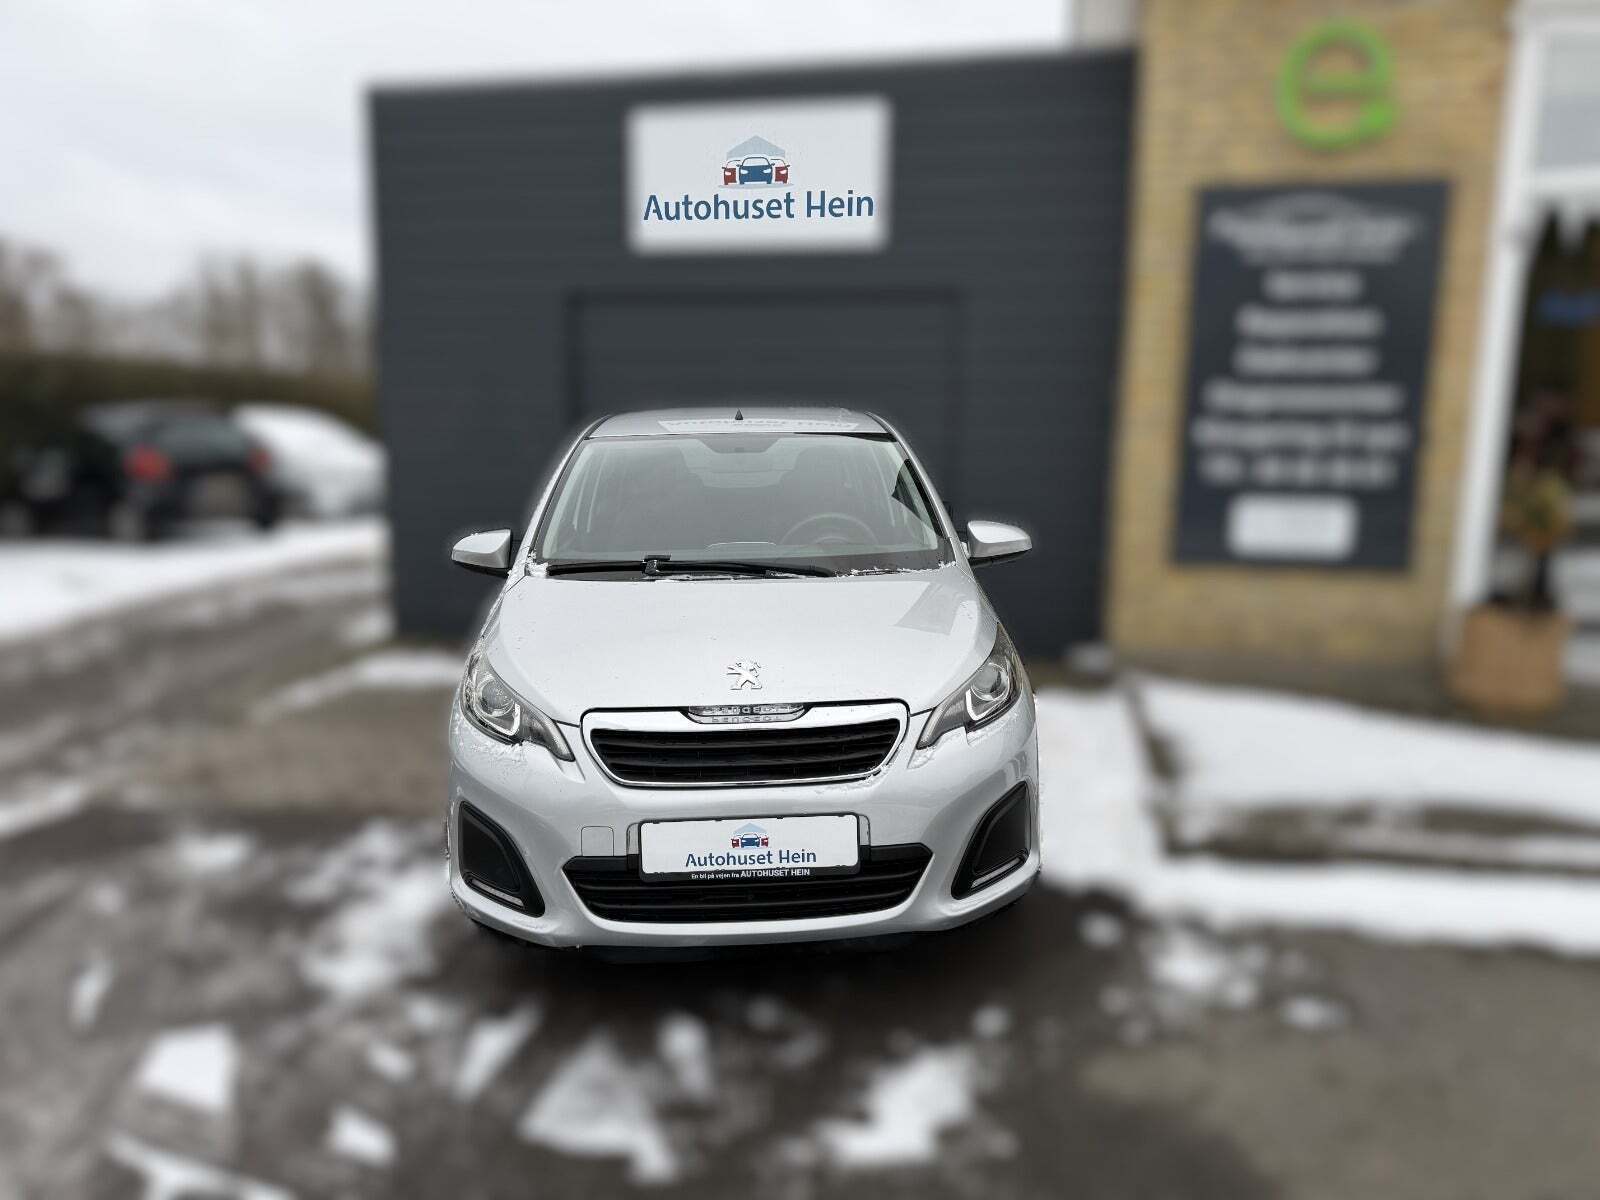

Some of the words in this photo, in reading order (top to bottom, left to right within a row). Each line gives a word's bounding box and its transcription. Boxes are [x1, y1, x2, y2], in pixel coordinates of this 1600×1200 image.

[643, 192, 795, 221] Autohuset
[807, 190, 874, 217] Hein
[685, 851, 773, 867] Autohuset
[779, 848, 817, 863] Hein
[740, 869, 789, 877] AUTOHUSET
[791, 868, 810, 876] HEIN
